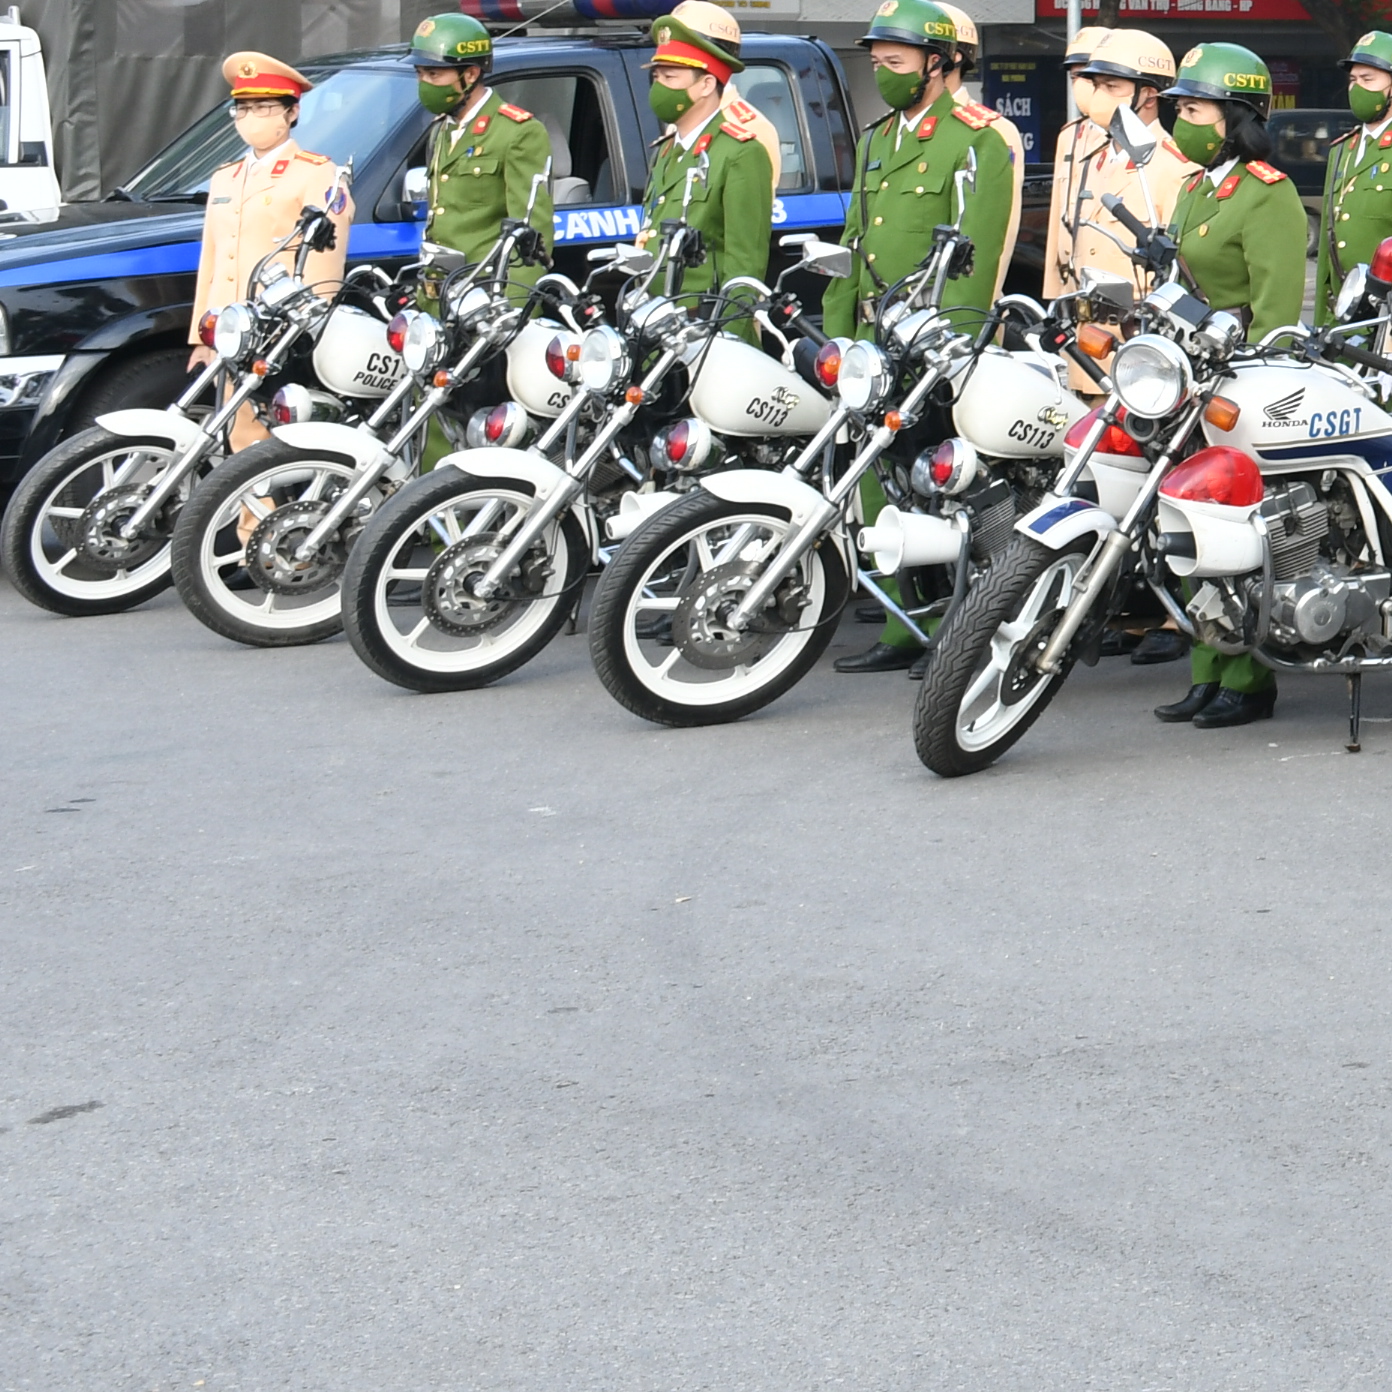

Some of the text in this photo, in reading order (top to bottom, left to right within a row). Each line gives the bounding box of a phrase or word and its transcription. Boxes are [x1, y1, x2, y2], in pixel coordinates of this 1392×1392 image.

[1224, 72, 1267, 89] CSTT
[995, 92, 1032, 117] SÁCH
[353, 370, 398, 392] POLICE
[745, 397, 789, 428] CS113
[1262, 419, 1309, 429] HONDA
[1308, 407, 1362, 438] CSGT
[1008, 419, 1056, 450] CS113
